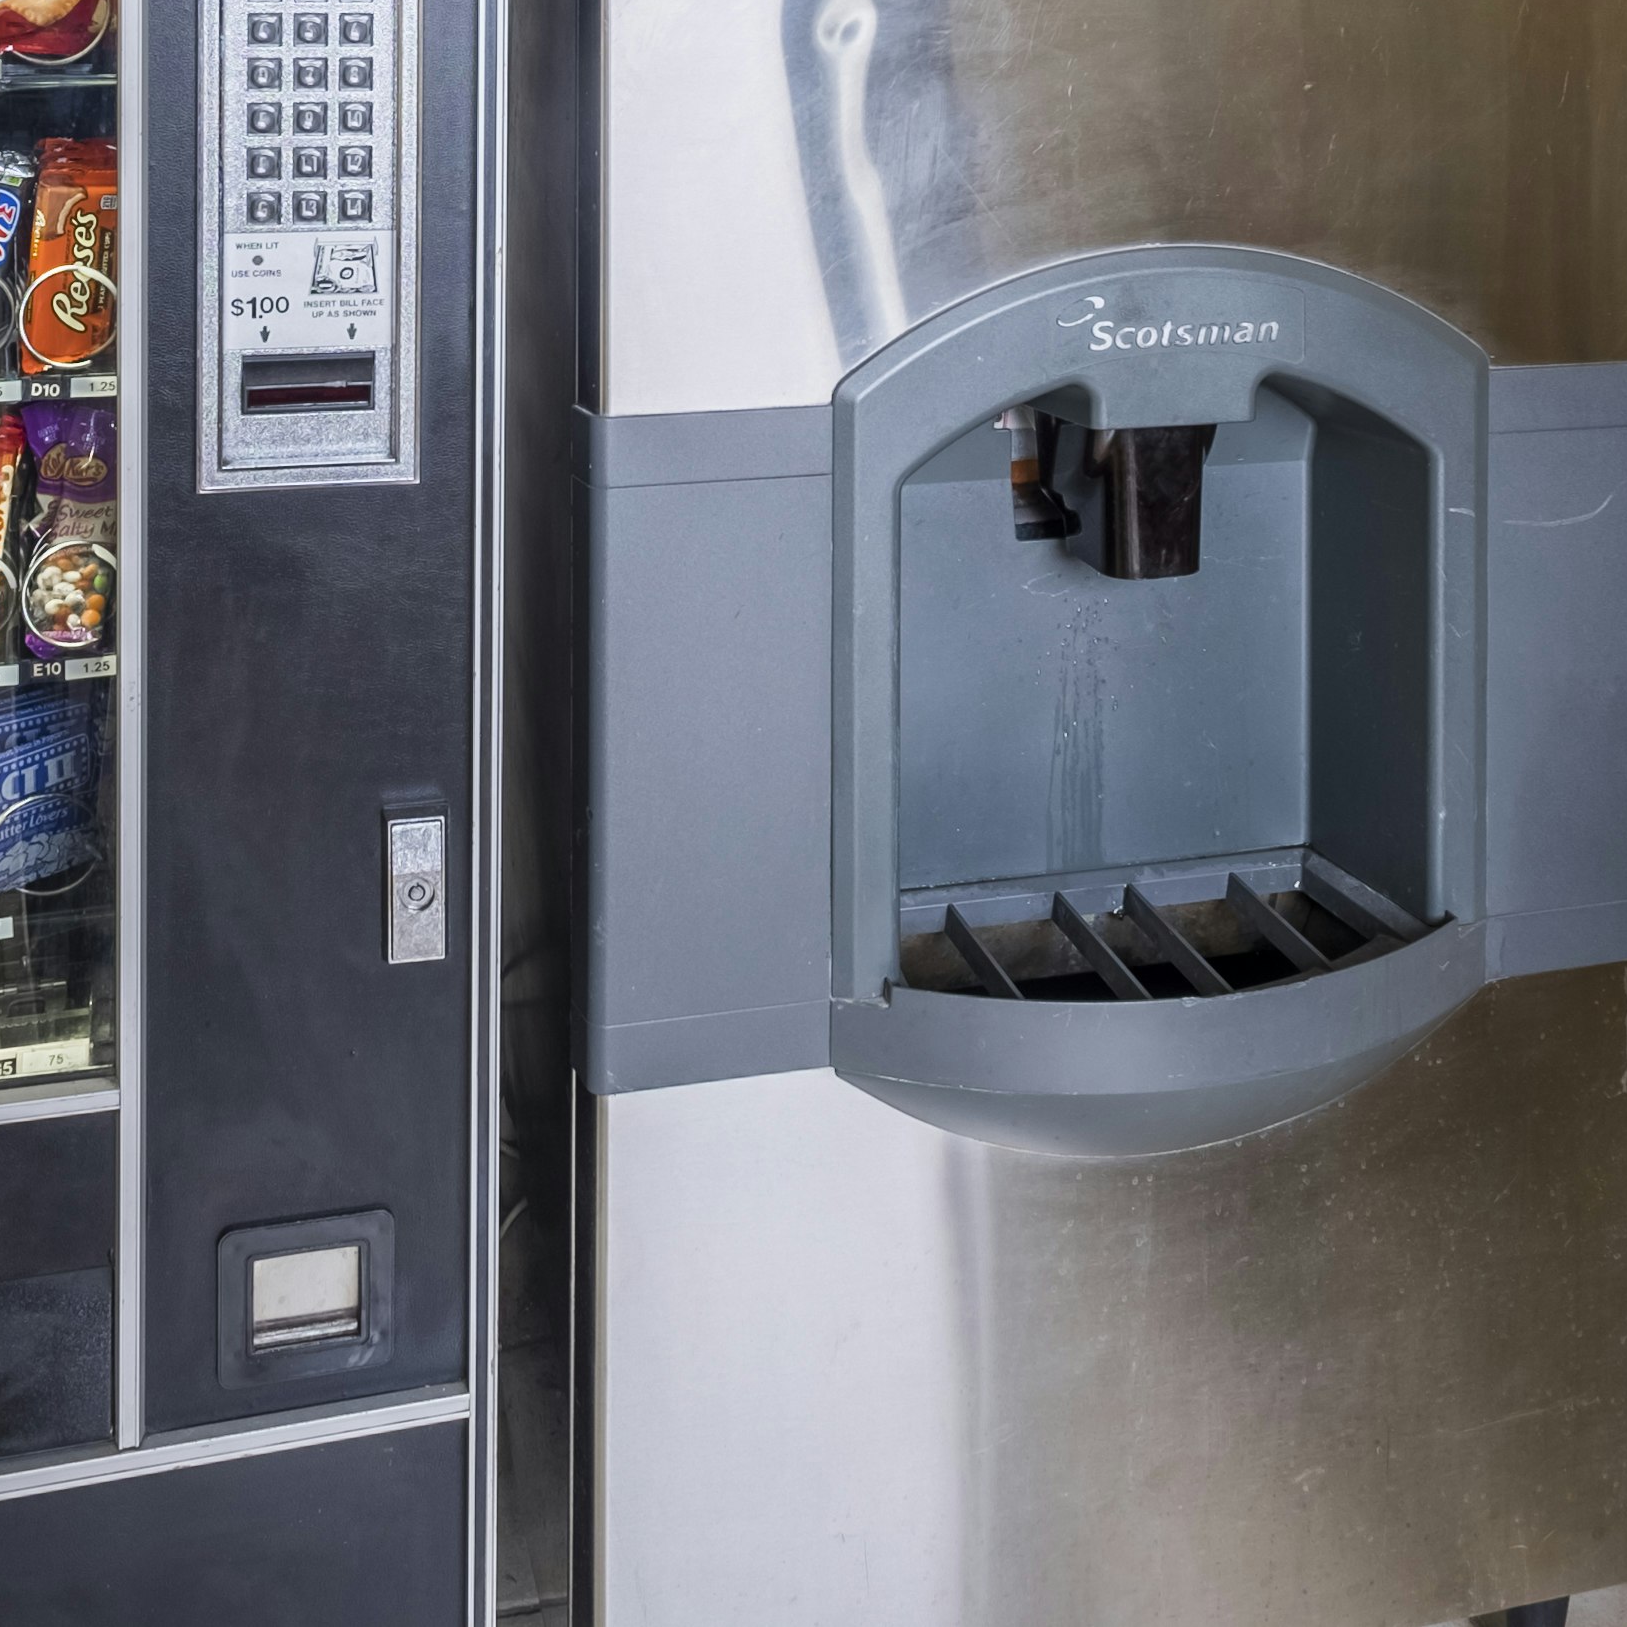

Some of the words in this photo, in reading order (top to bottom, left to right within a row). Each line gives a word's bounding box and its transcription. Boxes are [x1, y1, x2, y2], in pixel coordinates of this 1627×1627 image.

[235, 242, 263, 250] WHEN
[265, 241, 279, 249] LIT
[52, 208, 98, 333] Reese's
[230, 270, 250, 278] USE
[252, 269, 282, 278] COINS
[230, 296, 290, 319] $1.00
[303, 299, 337, 309] INSERT
[339, 299, 358, 308] BILL
[361, 298, 385, 307] FACE
[311, 311, 324, 319] UP
[327, 310, 340, 318] AS
[342, 309, 377, 318] SHOWN
[1088, 319, 1280, 351] Scotsman
[30, 383, 60, 398] D10
[33, 663, 62, 677] E10
[83, 662, 111, 673] 1.25
[29, 807, 69, 830] Lovers
